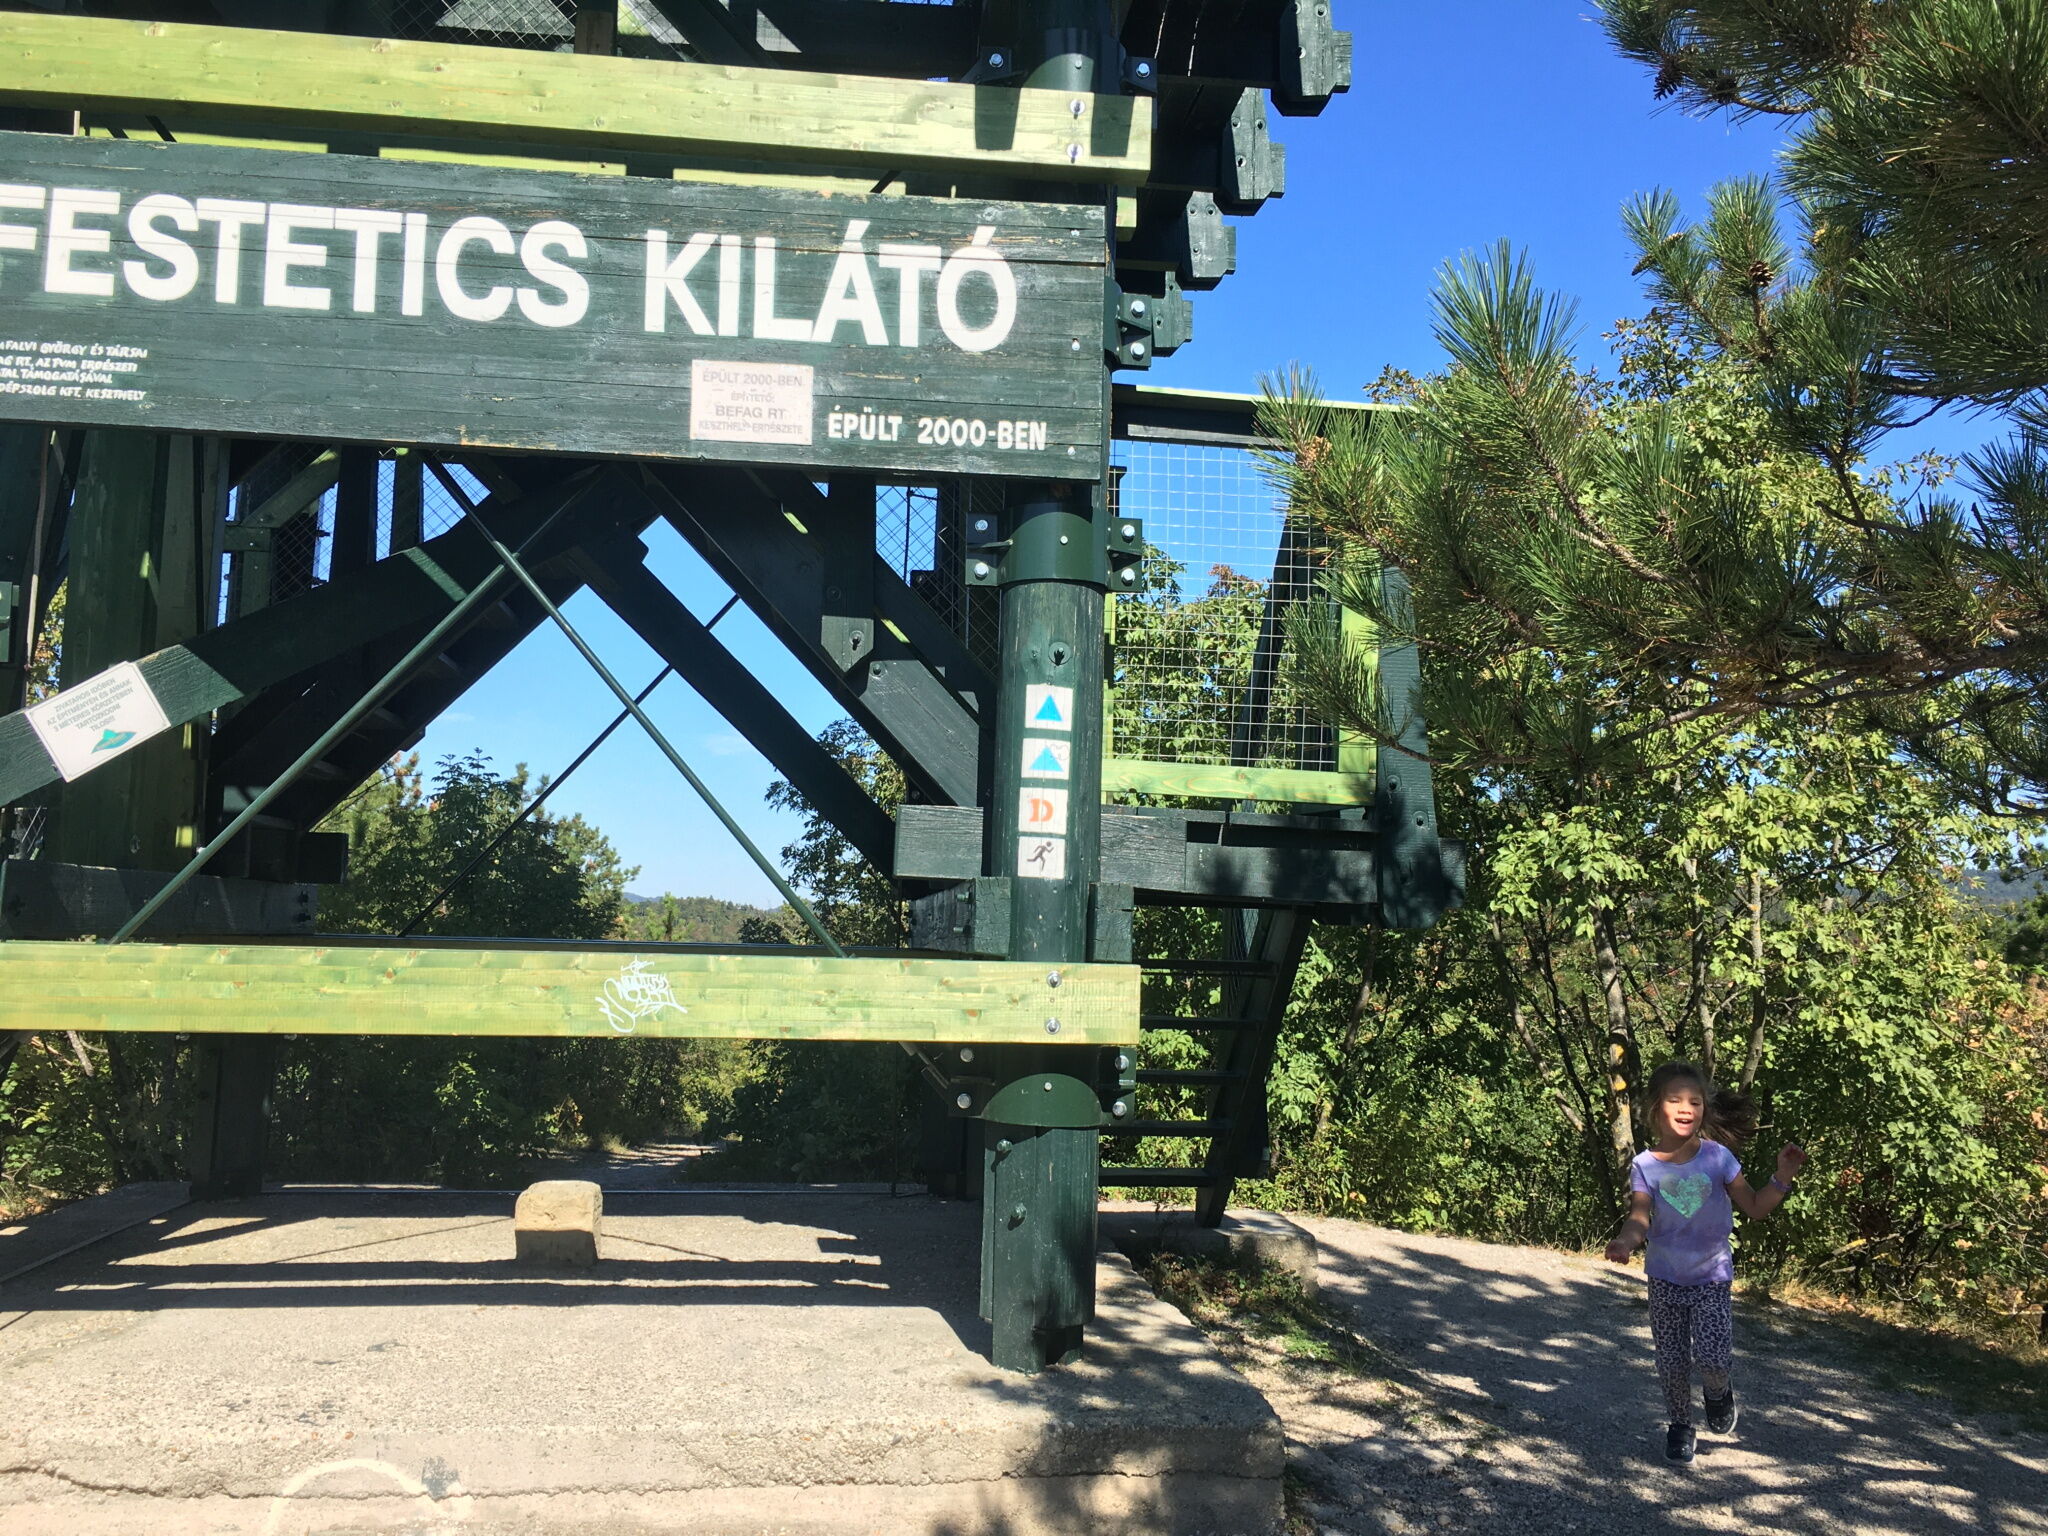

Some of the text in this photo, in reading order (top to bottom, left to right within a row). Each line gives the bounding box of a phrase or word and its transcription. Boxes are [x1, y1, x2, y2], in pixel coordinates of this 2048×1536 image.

[642, 219, 1018, 353] KILÁTÓ
[702, 368, 803, 387] ÉPÜLT 2000-BEN
[715, 405, 763, 419] BEFAG
[828, 404, 1048, 451] ÉPÜLT 2000-BEN
[1029, 798, 1054, 823] D
